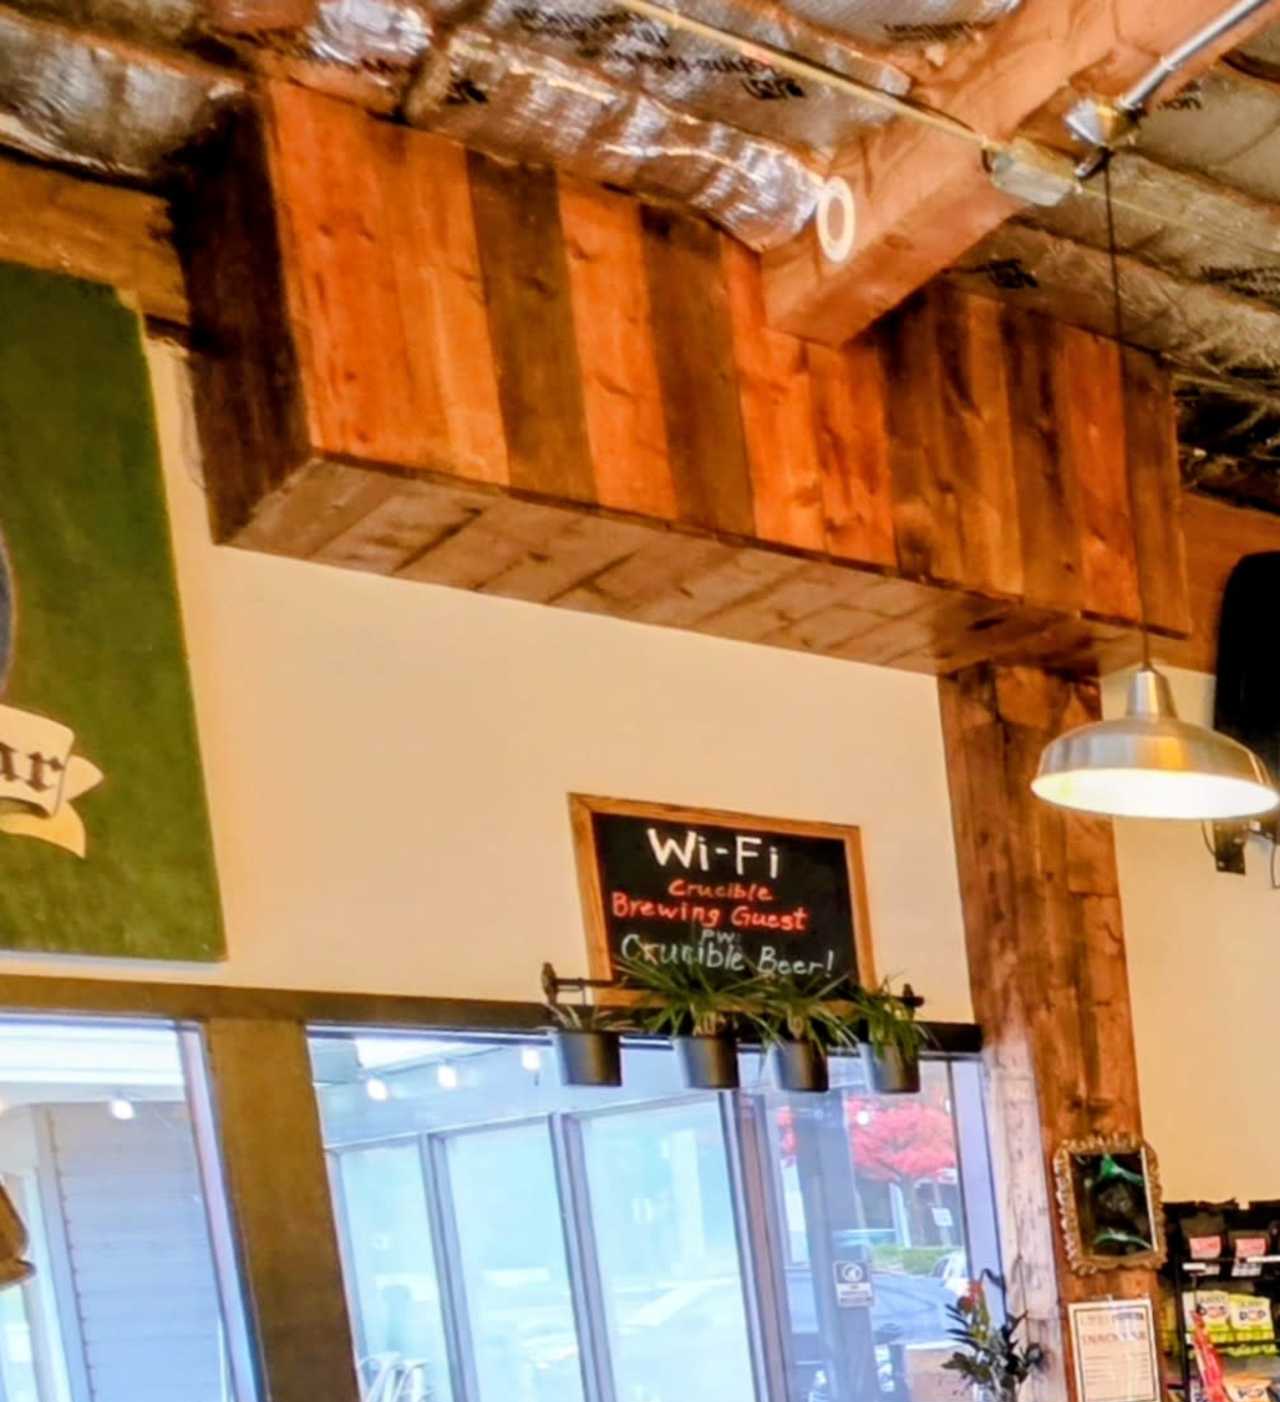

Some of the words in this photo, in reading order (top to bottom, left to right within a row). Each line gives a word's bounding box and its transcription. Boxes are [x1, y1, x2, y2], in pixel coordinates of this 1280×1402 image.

[647, 828, 779, 879] Wi-Fi
[668, 879, 773, 901] Crucible
[611, 891, 721, 927] Brewing
[731, 905, 808, 931] Guest
